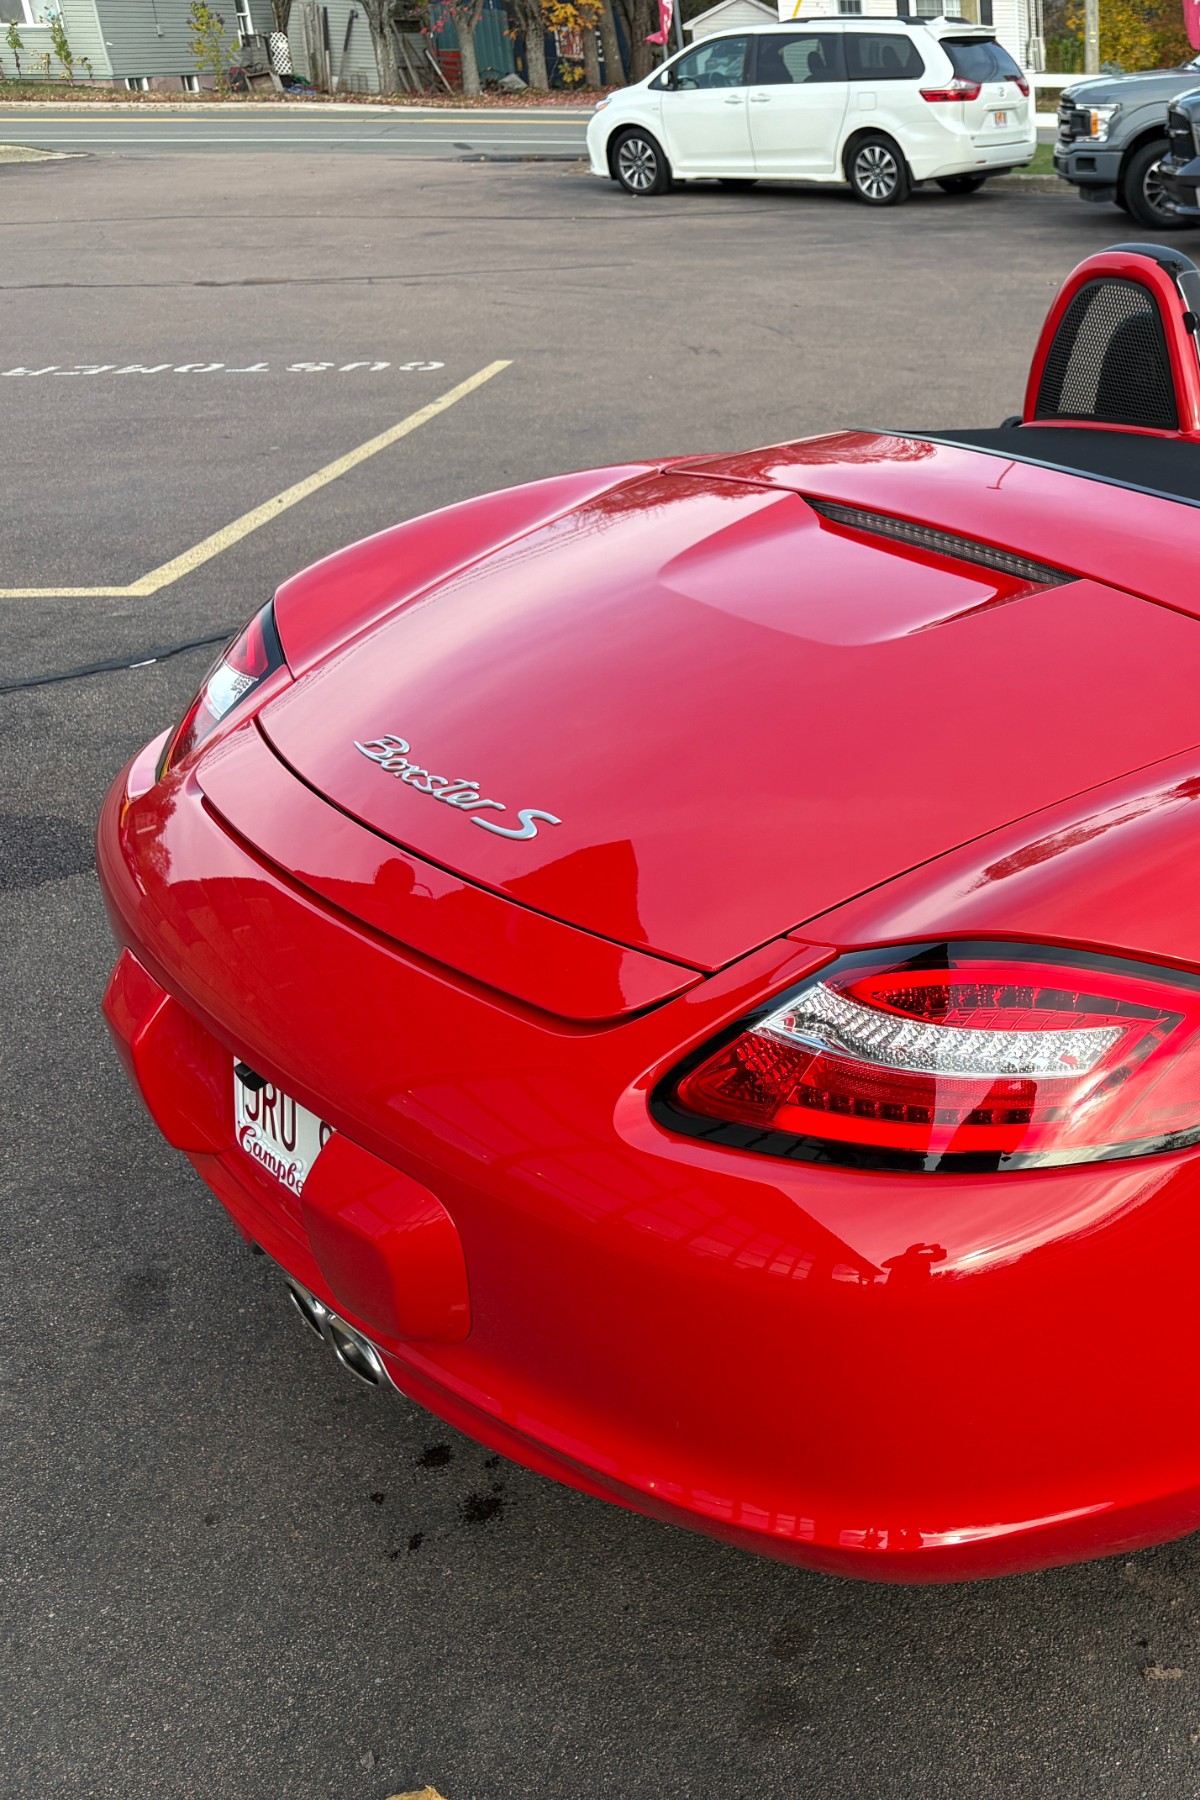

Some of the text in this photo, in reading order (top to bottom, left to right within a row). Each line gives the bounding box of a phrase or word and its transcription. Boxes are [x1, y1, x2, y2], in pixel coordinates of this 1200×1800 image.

[0, 361, 446, 377] CUSTOMER
[353, 733, 563, 841] Boxster S
